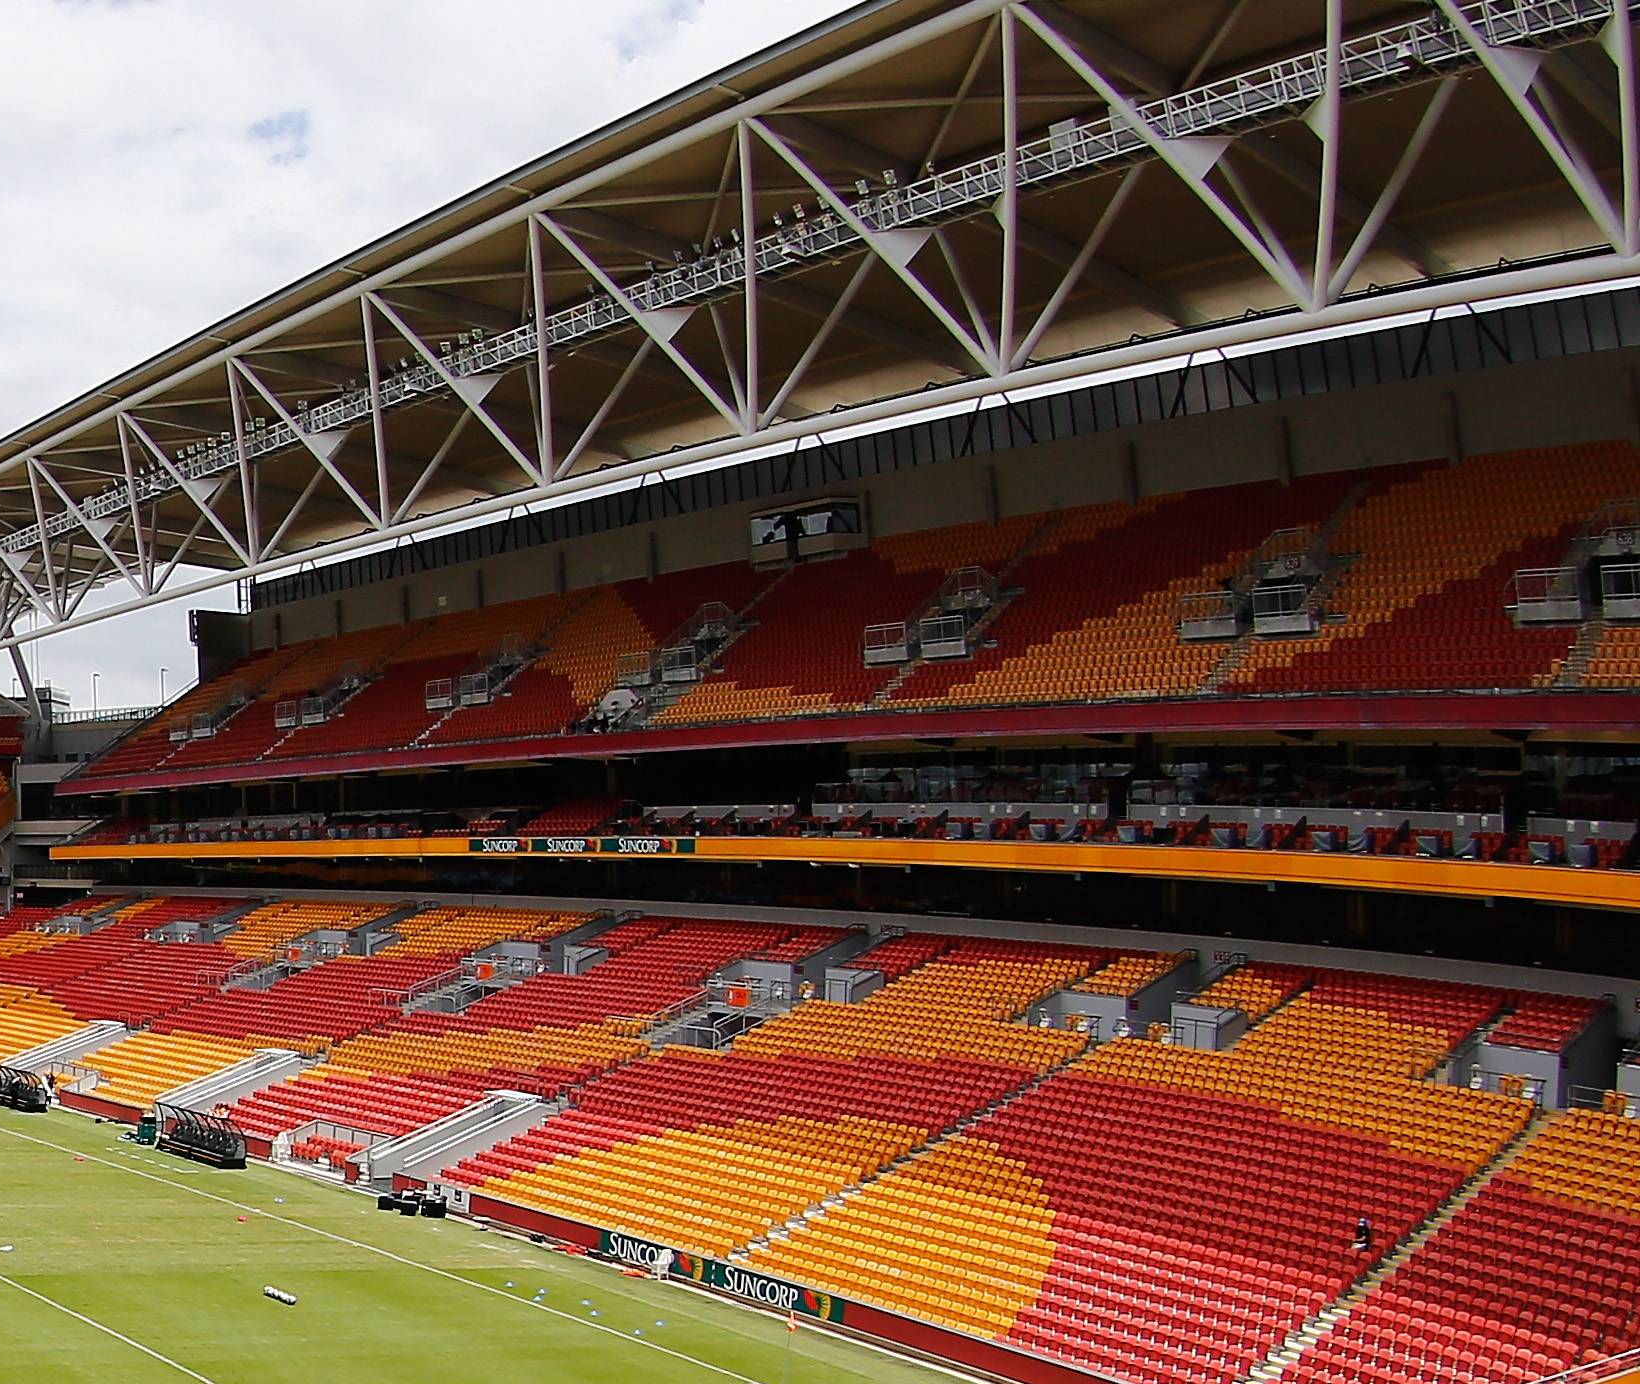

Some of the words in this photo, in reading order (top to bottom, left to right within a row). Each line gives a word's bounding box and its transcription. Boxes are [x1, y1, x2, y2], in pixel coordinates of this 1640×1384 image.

[482, 838, 518, 852] SUNCORP
[546, 838, 585, 852] SUNCORP
[618, 838, 660, 853] SUNCORP
[609, 1233, 665, 1268] SUNCO
[723, 1267, 798, 1309] SUNCORP
